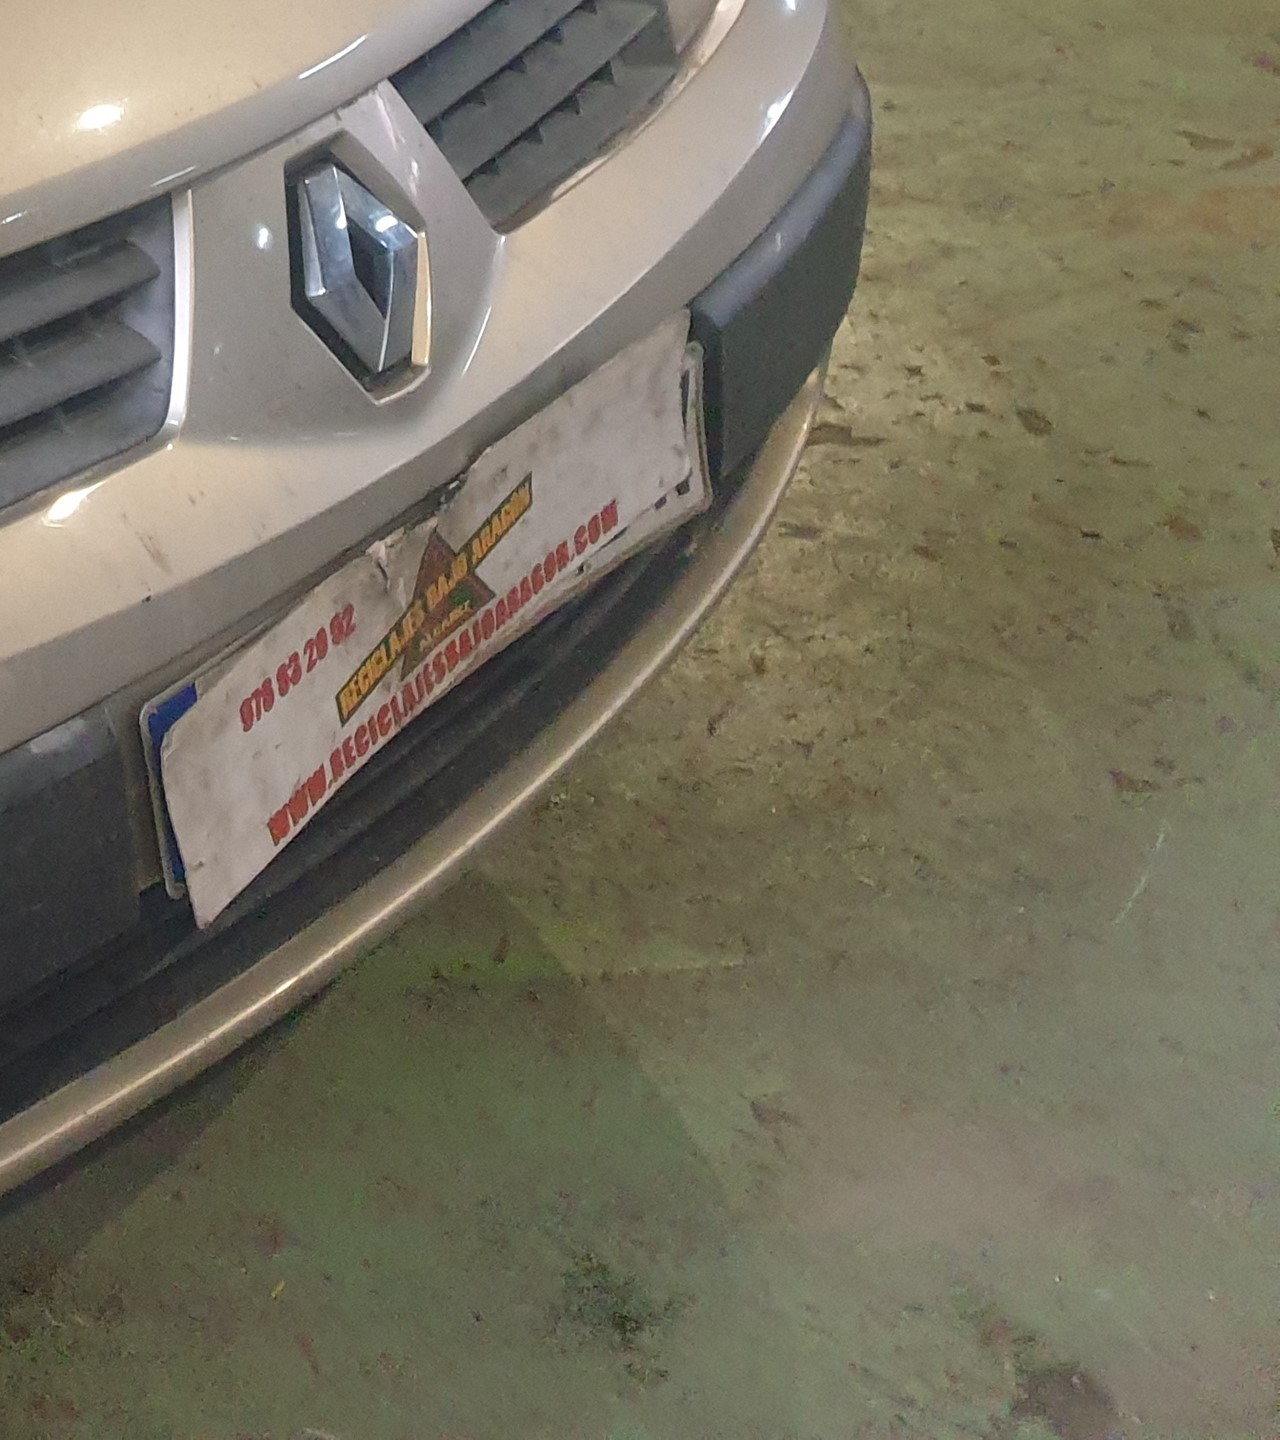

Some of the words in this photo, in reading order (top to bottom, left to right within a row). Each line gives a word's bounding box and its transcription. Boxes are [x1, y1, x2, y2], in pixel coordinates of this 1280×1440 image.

[426, 552, 468, 611] BAJO
[266, 498, 619, 847] WWW.RECICLAJESBAJOARAGON.COM
[304, 626, 328, 673] 20
